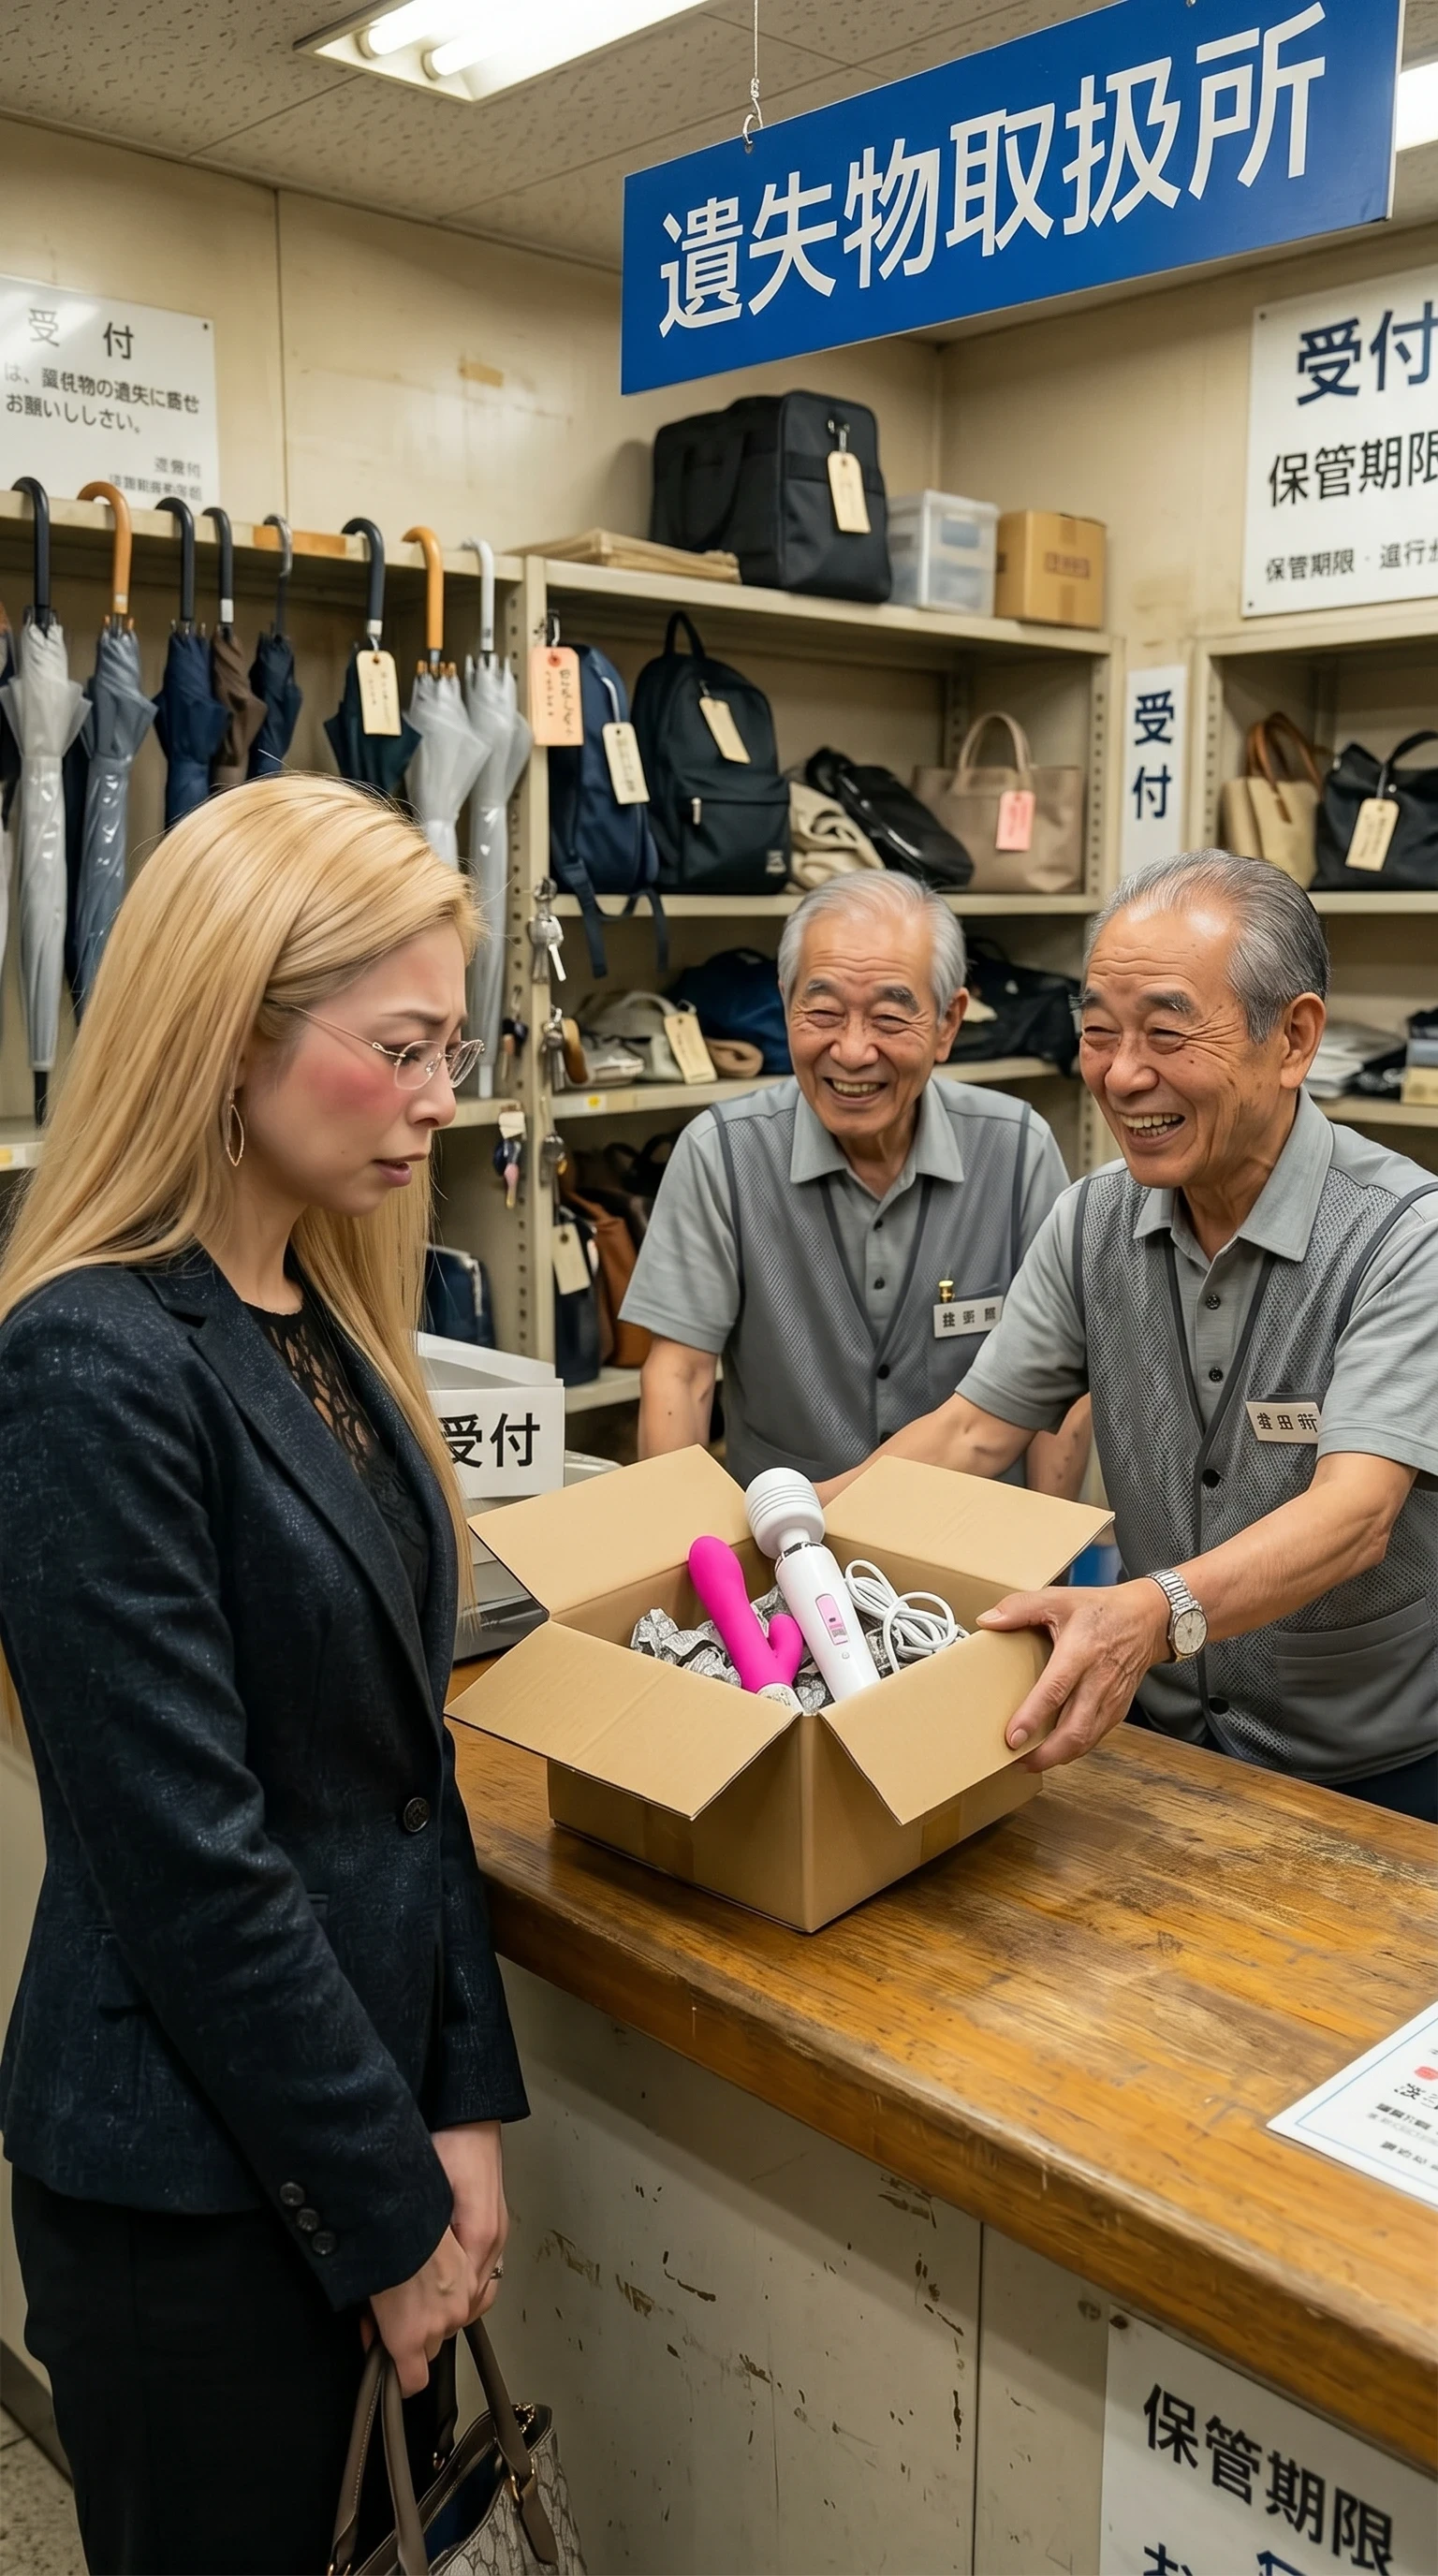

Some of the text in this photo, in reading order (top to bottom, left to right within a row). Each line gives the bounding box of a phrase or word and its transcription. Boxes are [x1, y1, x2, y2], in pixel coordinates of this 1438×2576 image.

[659, 1, 1326, 338] 遺失物取扱所
[1297, 300, 1438, 405] 受付
[1269, 431, 1438, 507] 保管期限
[1133, 690, 1175, 821] 受付
[438, 1412, 540, 1469] 受付
[1143, 2382, 1393, 2576] 保管期限
